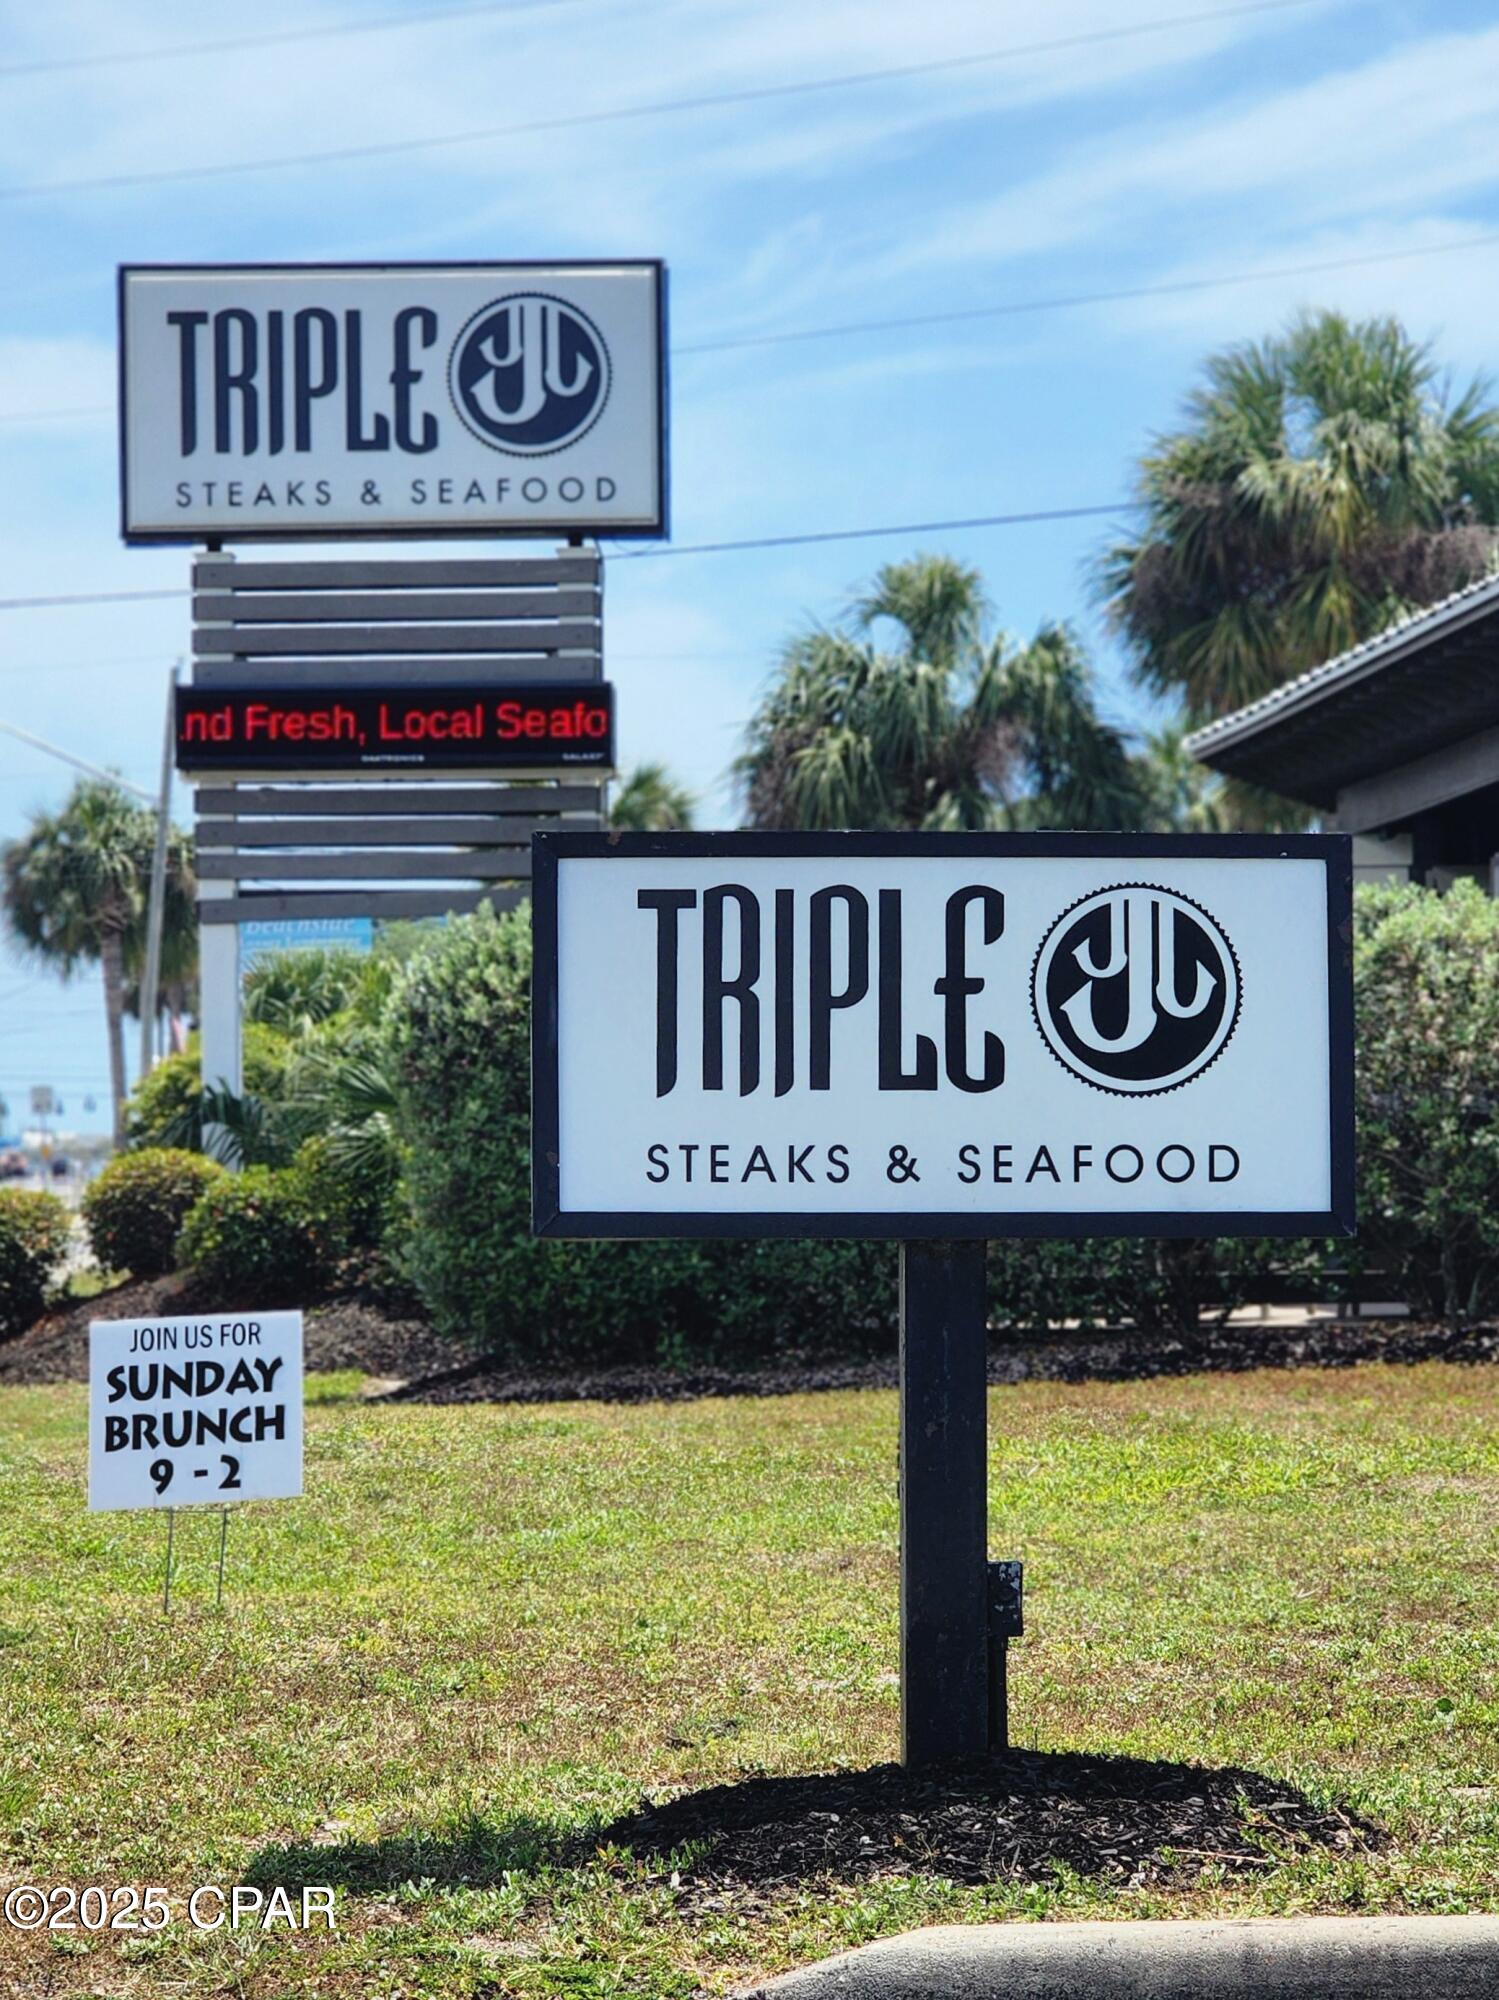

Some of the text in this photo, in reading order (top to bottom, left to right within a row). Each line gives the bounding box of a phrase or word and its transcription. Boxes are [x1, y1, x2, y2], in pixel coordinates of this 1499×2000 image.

[167, 306, 439, 457] TRIPLE
[176, 476, 617, 508] STEAKS & SEAFOOD
[244, 702, 366, 746] Fresh,
[378, 702, 485, 741] Local
[495, 700, 608, 740] Seafo
[638, 884, 1006, 1098] TRIPLE
[646, 1143, 1241, 1184] STEAKS & SEAFOOD
[130, 1322, 261, 1352] JOIN US FOR
[107, 1356, 283, 1403] SUNDAY
[105, 1405, 285, 1452] BRUNCH
